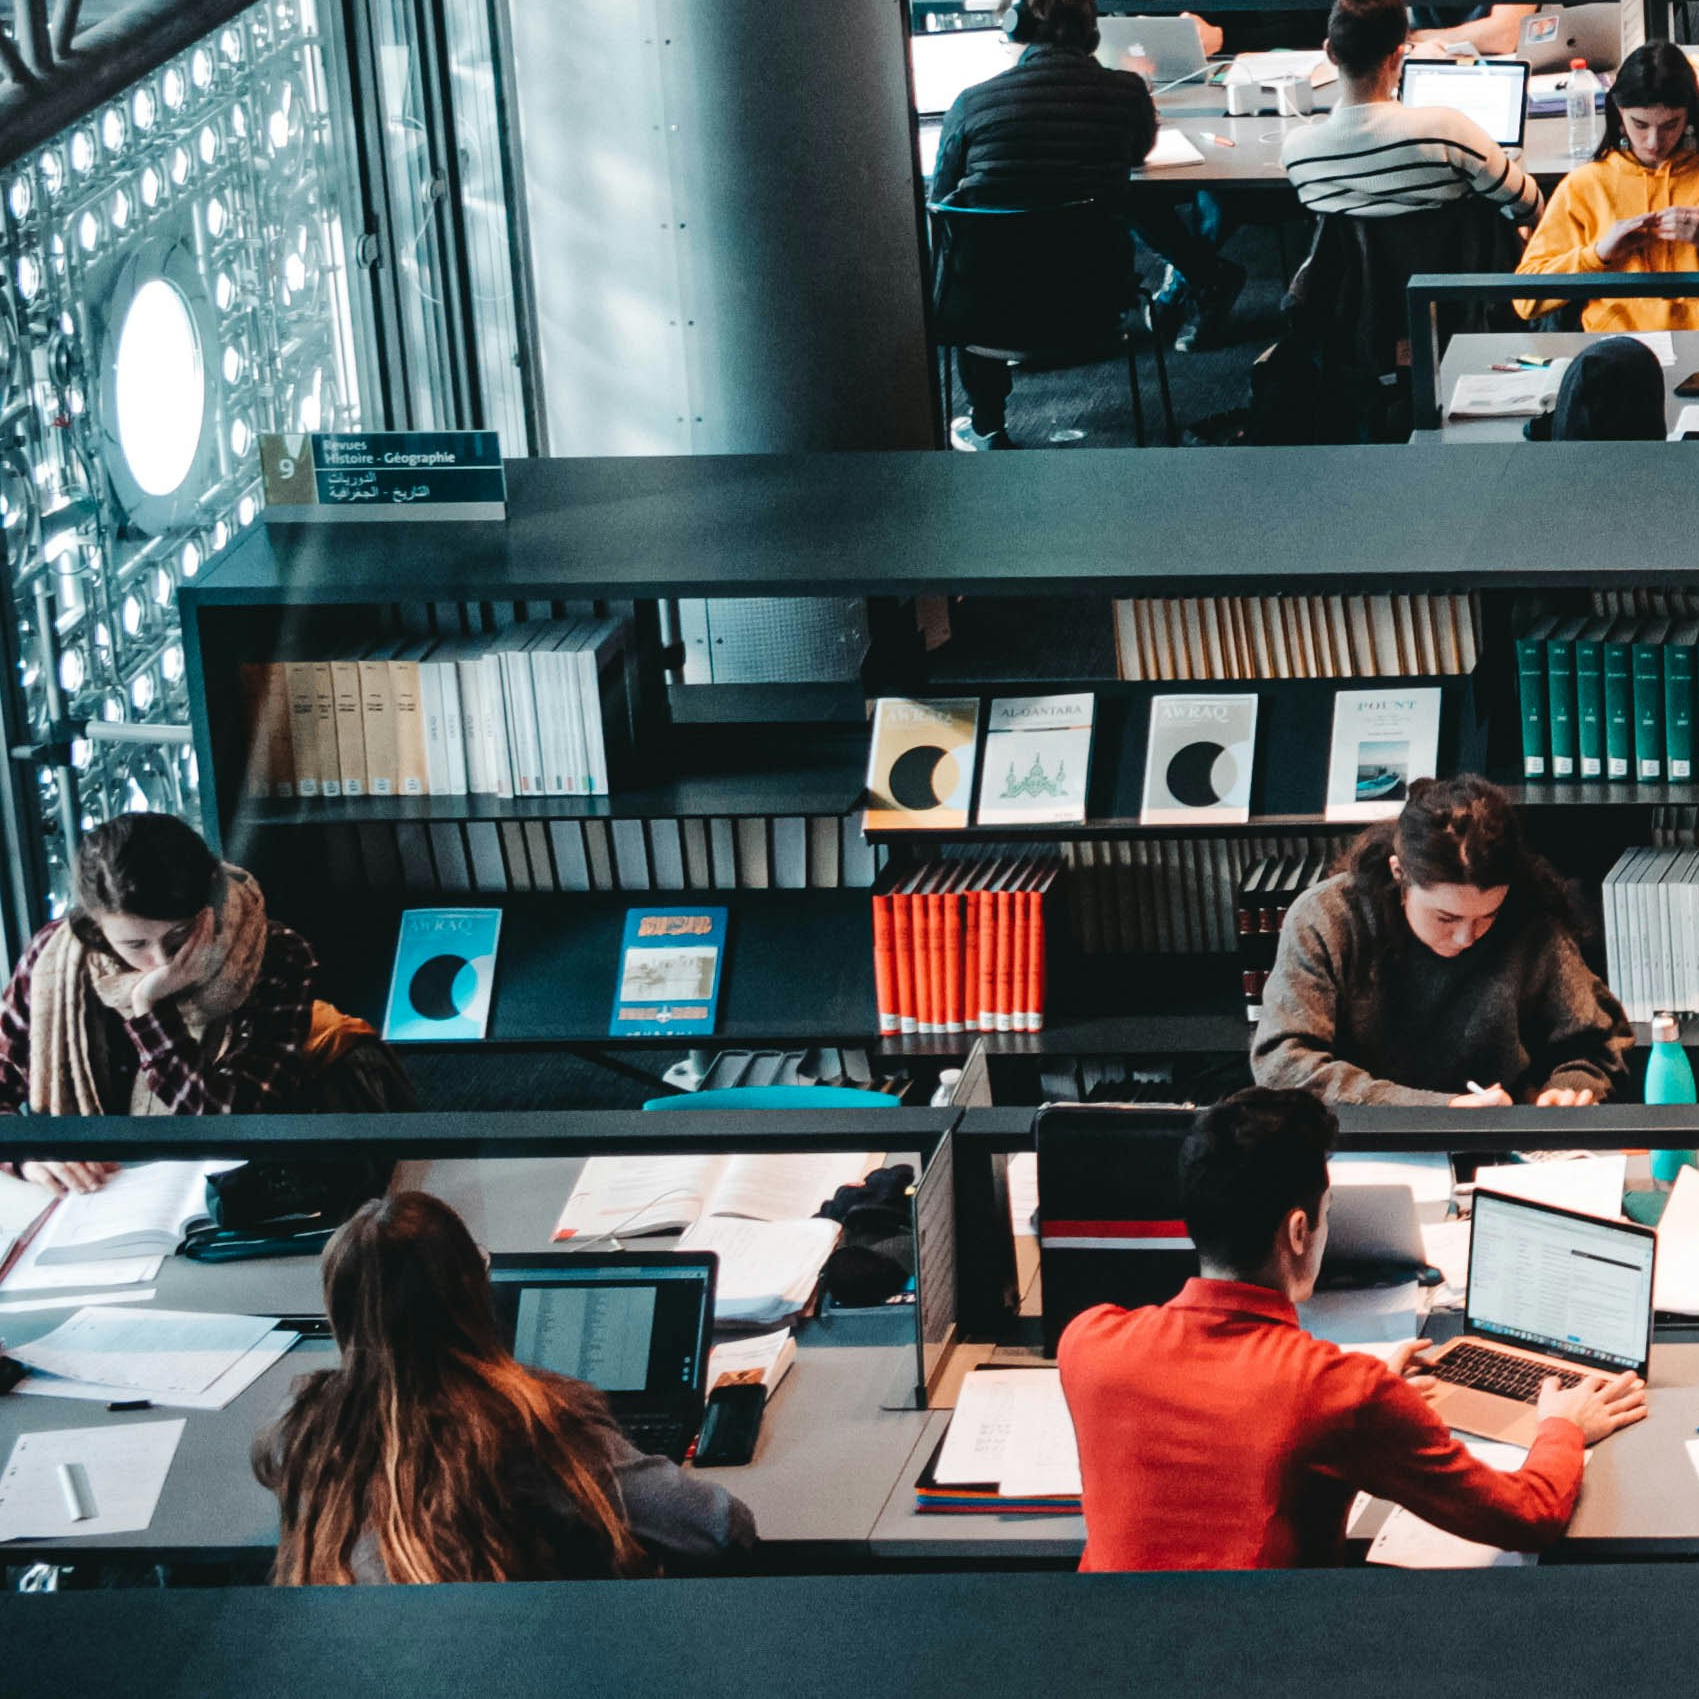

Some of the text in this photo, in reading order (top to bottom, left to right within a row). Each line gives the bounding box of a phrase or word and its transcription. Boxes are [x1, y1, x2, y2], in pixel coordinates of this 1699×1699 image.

[323, 439, 367, 450] Revues
[325, 452, 373, 464] Histoire
[384, 451, 456, 466] Géographie
[279, 458, 295, 479] 9
[1001, 704, 1083, 718] AL-QANTARA
[1161, 704, 1231, 722] AWRAQ
